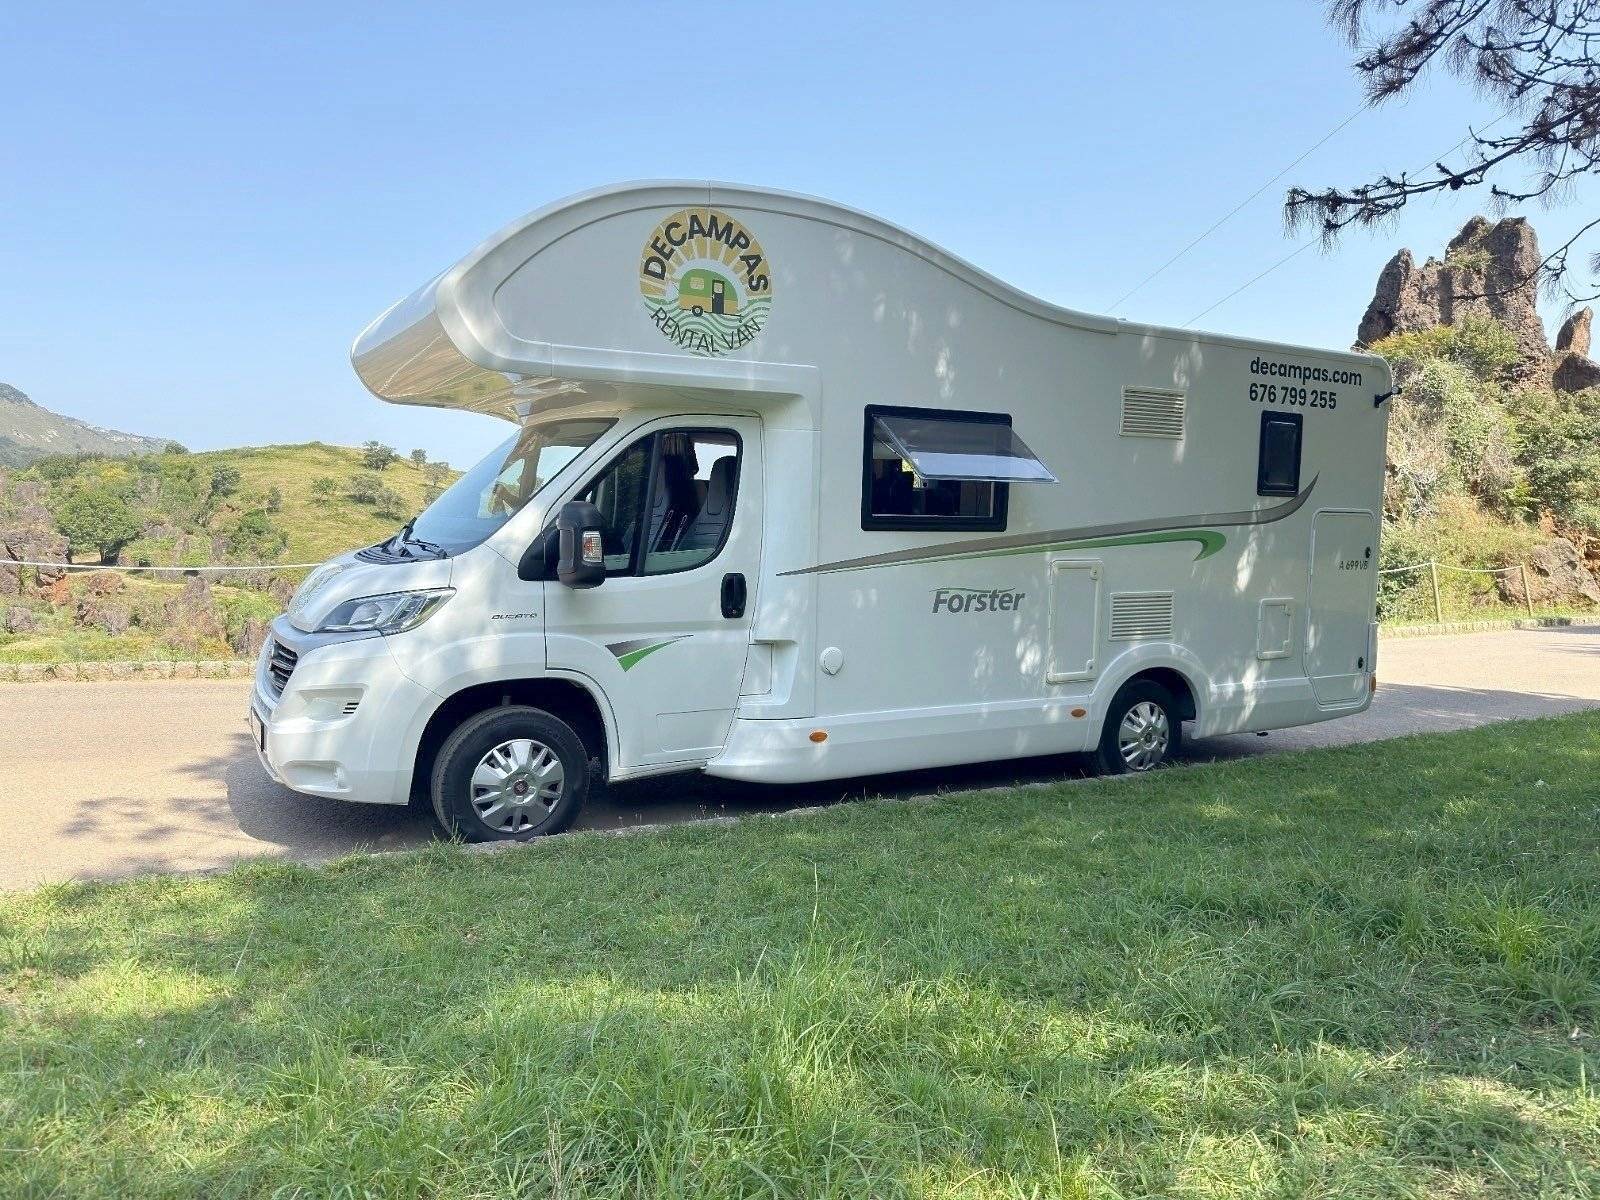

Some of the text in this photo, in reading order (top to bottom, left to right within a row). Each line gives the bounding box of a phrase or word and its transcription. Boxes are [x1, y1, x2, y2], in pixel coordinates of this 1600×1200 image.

[643, 214, 769, 292] DECAMPAS
[650, 306, 761, 352] RENTAL VAN
[1250, 357, 1362, 385] decampas.com
[1249, 383, 1337, 409] 676 799 255
[932, 589, 1026, 613] Forster
